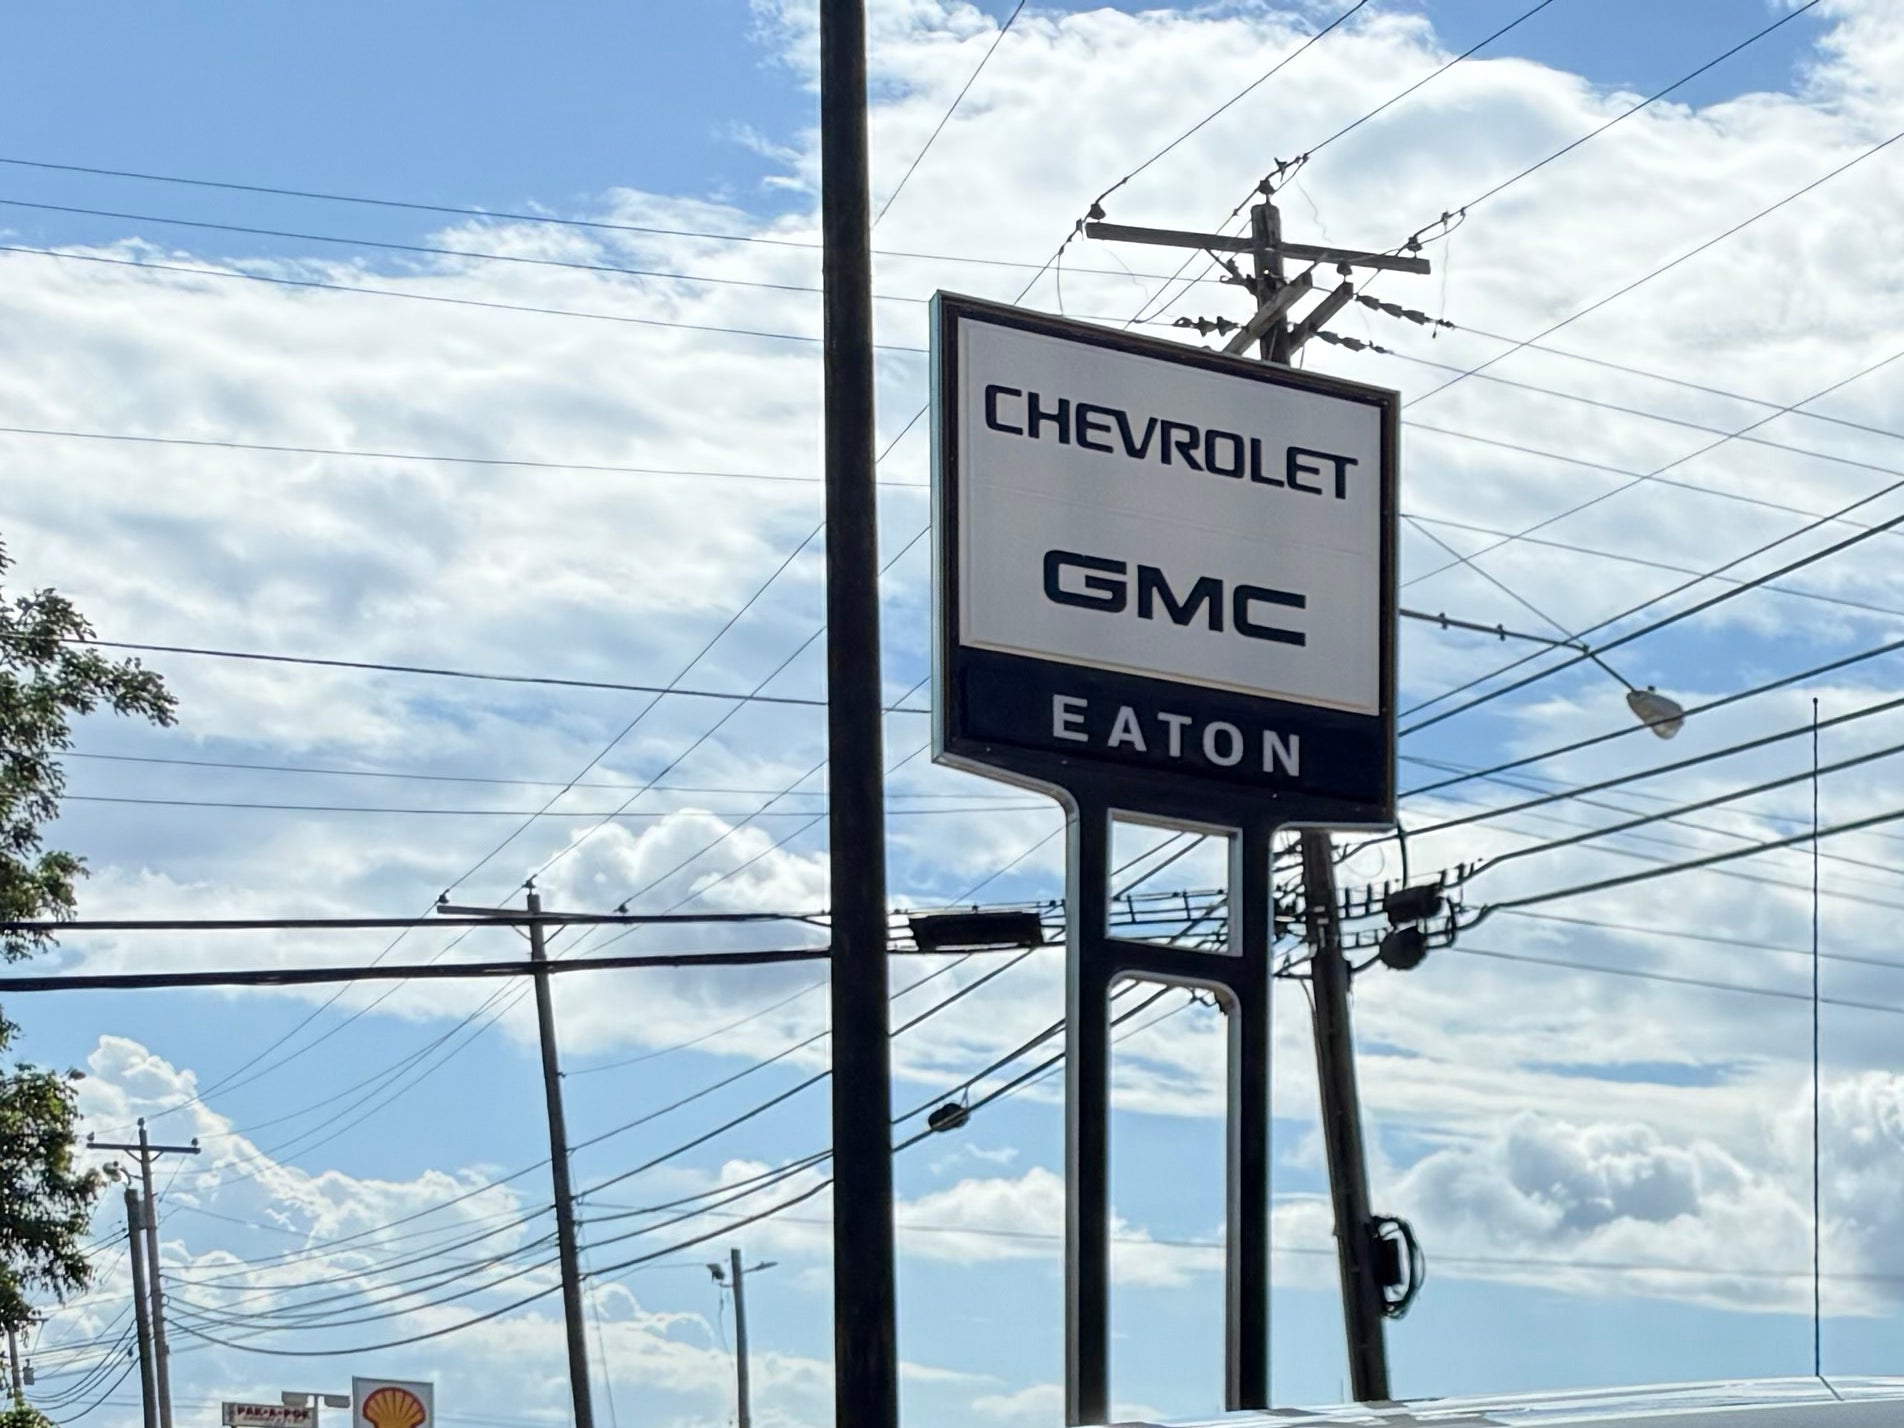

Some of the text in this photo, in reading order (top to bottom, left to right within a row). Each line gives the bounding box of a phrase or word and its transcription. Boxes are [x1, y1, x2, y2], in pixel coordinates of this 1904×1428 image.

[984, 384, 1358, 500] CHEVROLET
[1043, 549, 1306, 647] GMC
[1053, 694, 1300, 777] EATON
